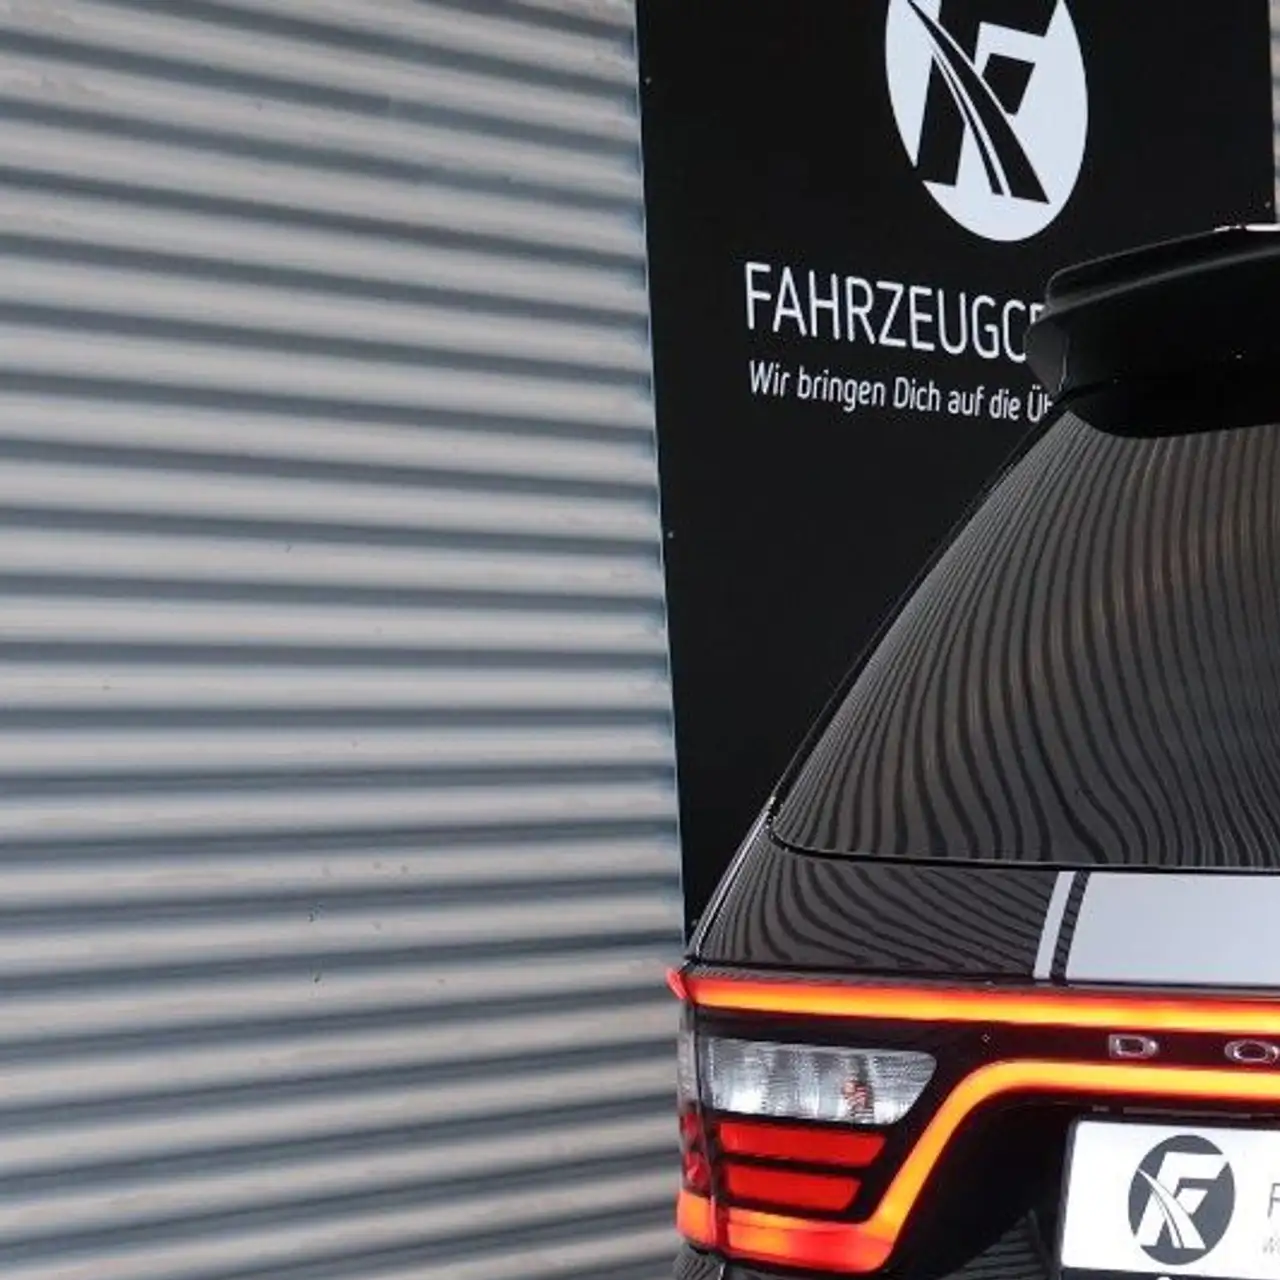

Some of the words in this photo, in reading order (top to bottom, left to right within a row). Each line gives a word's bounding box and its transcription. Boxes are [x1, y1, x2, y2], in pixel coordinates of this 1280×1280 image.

[749, 359, 791, 397] Wir
[796, 365, 886, 412] bringen
[893, 375, 942, 412] Dich
[948, 384, 986, 417] auf
[988, 386, 1021, 420] die
